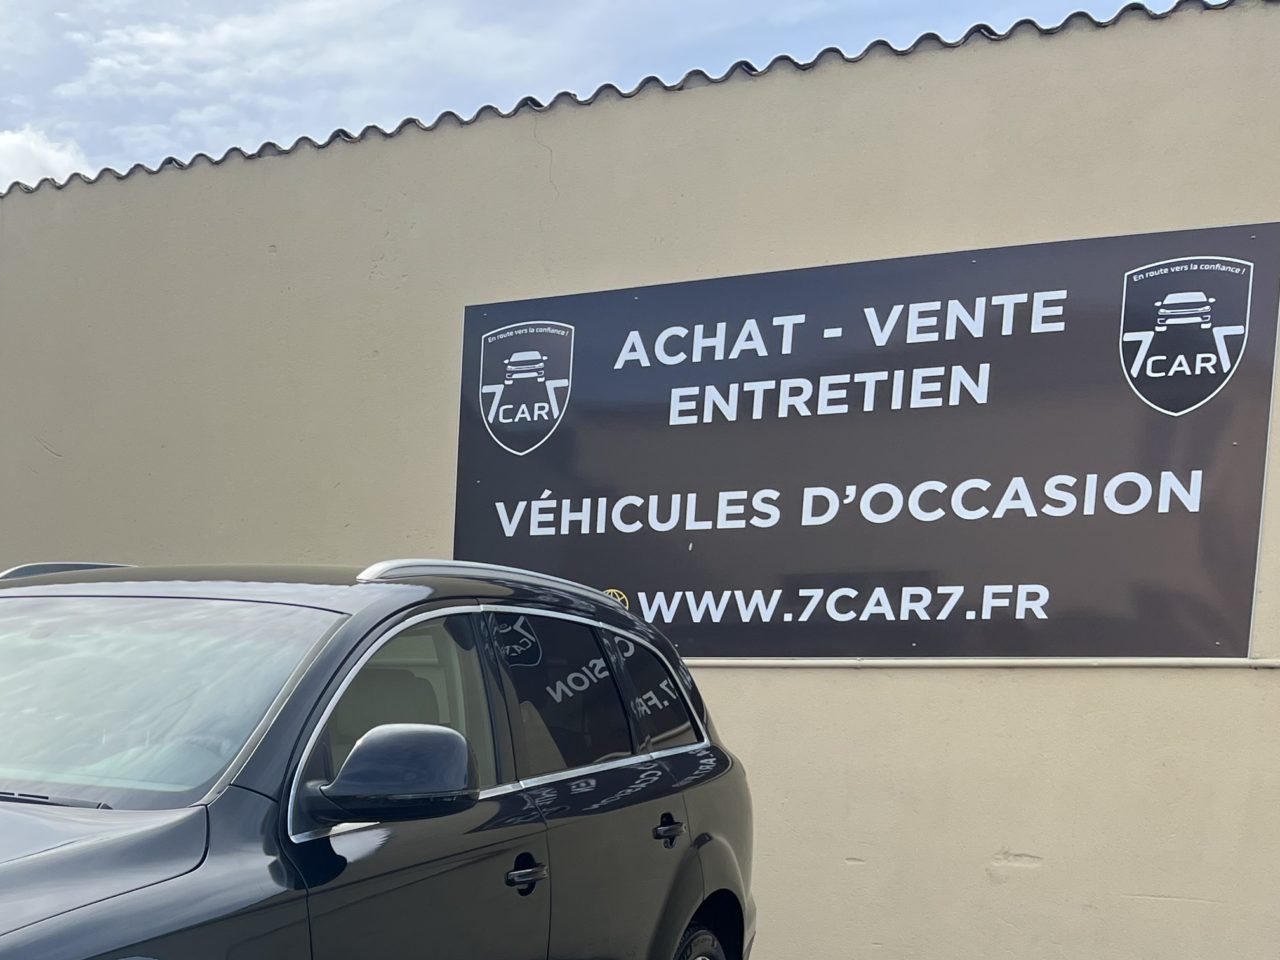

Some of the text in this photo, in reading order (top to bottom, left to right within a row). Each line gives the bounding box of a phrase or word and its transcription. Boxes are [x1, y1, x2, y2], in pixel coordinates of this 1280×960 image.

[613, 313, 806, 370] ACHAT
[863, 289, 1068, 347] VENTE
[669, 362, 991, 426] ENTRETIEN
[494, 487, 781, 537] VÉHICULES
[637, 584, 1051, 624] WWW.7CAR7.FR
